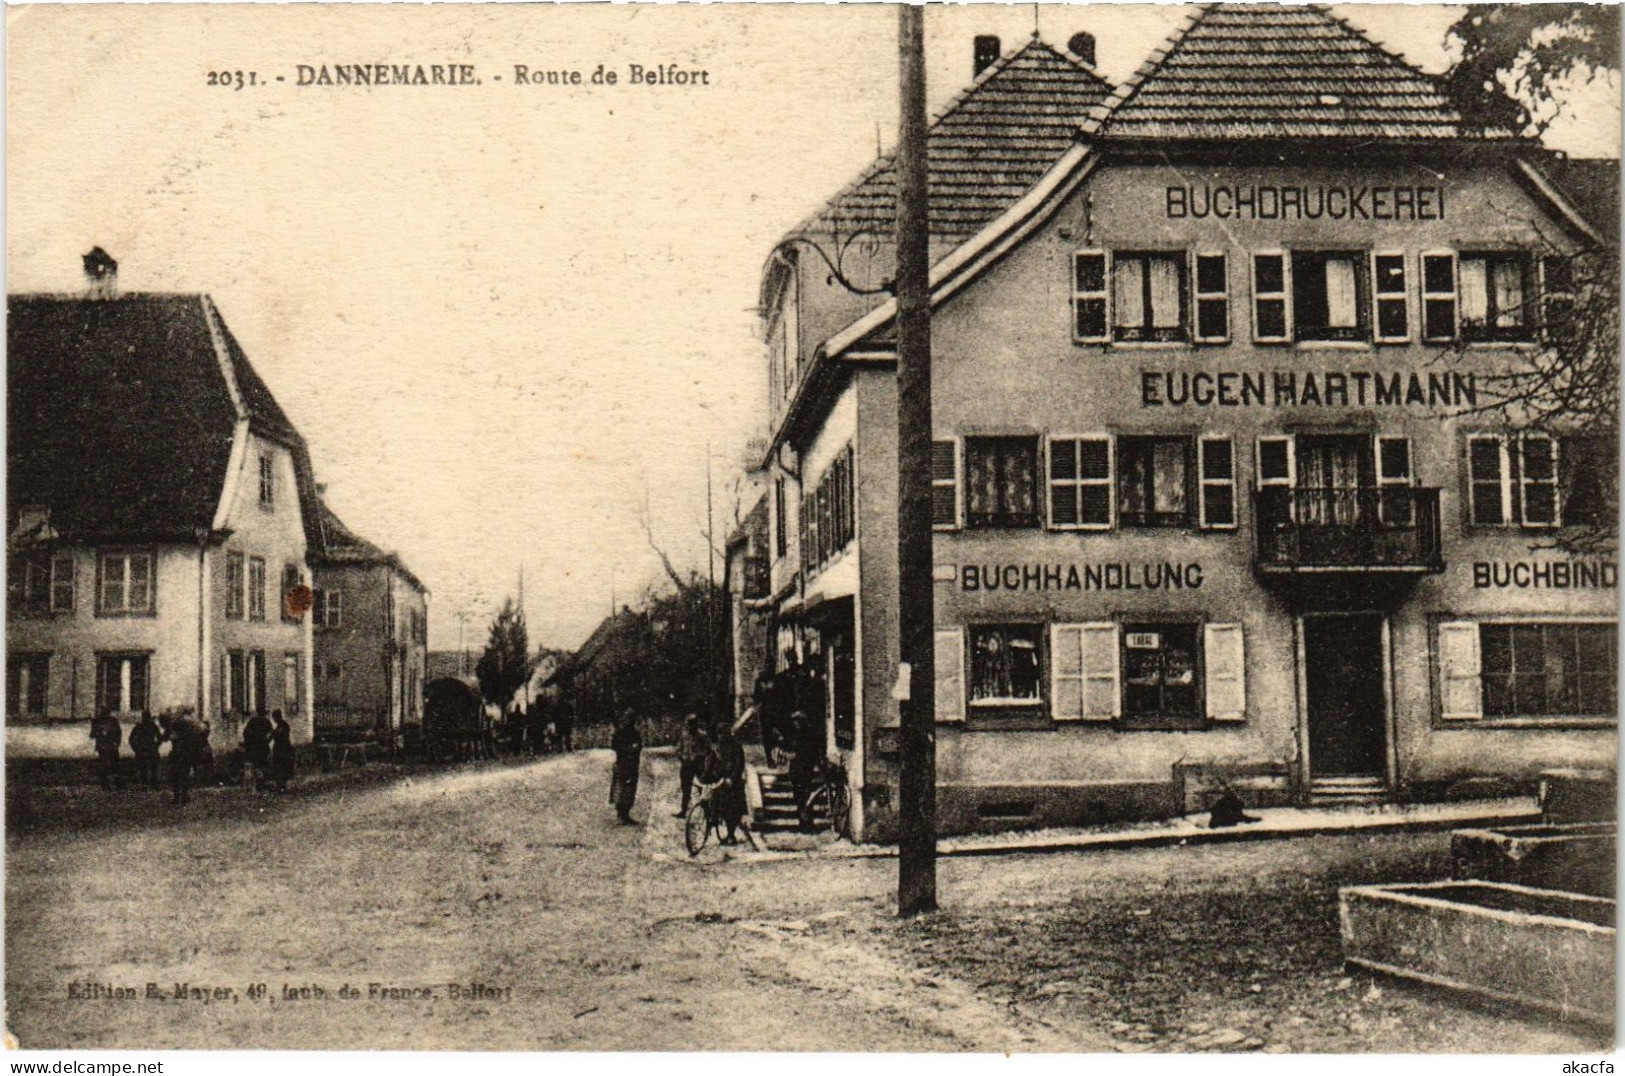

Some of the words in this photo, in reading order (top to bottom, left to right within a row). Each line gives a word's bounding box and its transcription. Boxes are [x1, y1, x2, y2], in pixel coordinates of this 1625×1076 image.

[1166, 186, 1445, 220] BUCHDRUCKEREI
[1141, 371, 1266, 407] EUGEN
[1273, 370, 1477, 407] HARTMANN
[961, 562, 1204, 591] BUCHHANDLUNG
[1473, 561, 1618, 588] BUCHBIND
